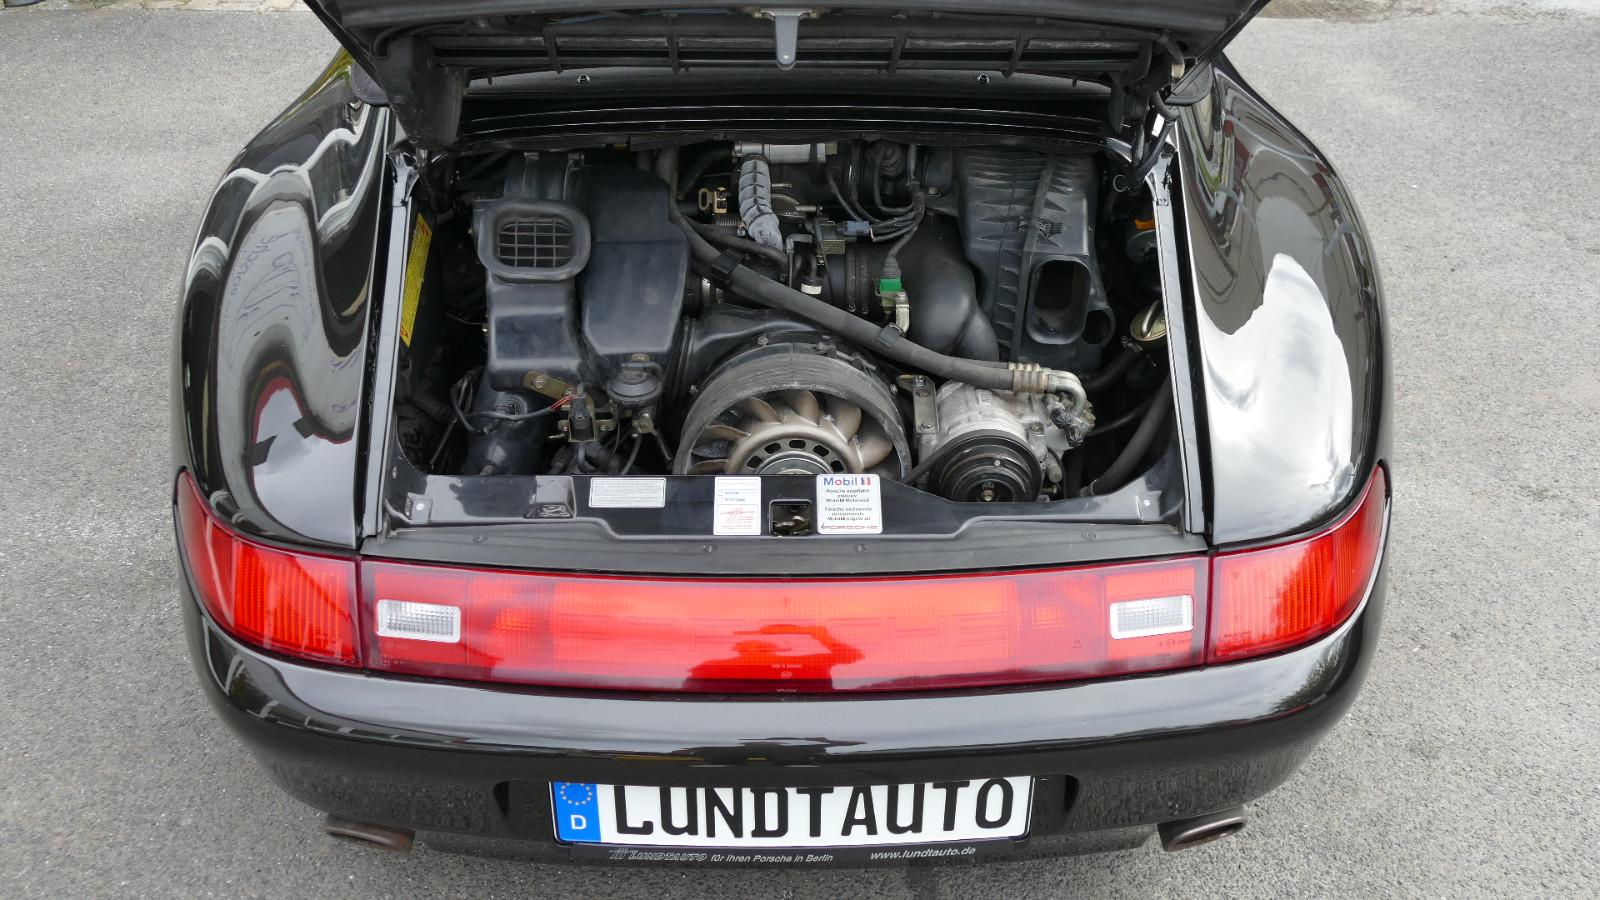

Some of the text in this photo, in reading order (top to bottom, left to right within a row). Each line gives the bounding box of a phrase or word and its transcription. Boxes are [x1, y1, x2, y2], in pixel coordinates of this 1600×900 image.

[823, 477, 858, 486] Mobil
[613, 778, 1015, 837] LUNDTAUTO
[570, 814, 587, 831] D
[710, 854, 725, 862] für
[726, 854, 751, 862] Ihren
[753, 855, 792, 863] Porsche
[794, 854, 803, 862] in
[805, 854, 834, 862] Berlin
[870, 847, 976, 860] www.lundtauto.de
